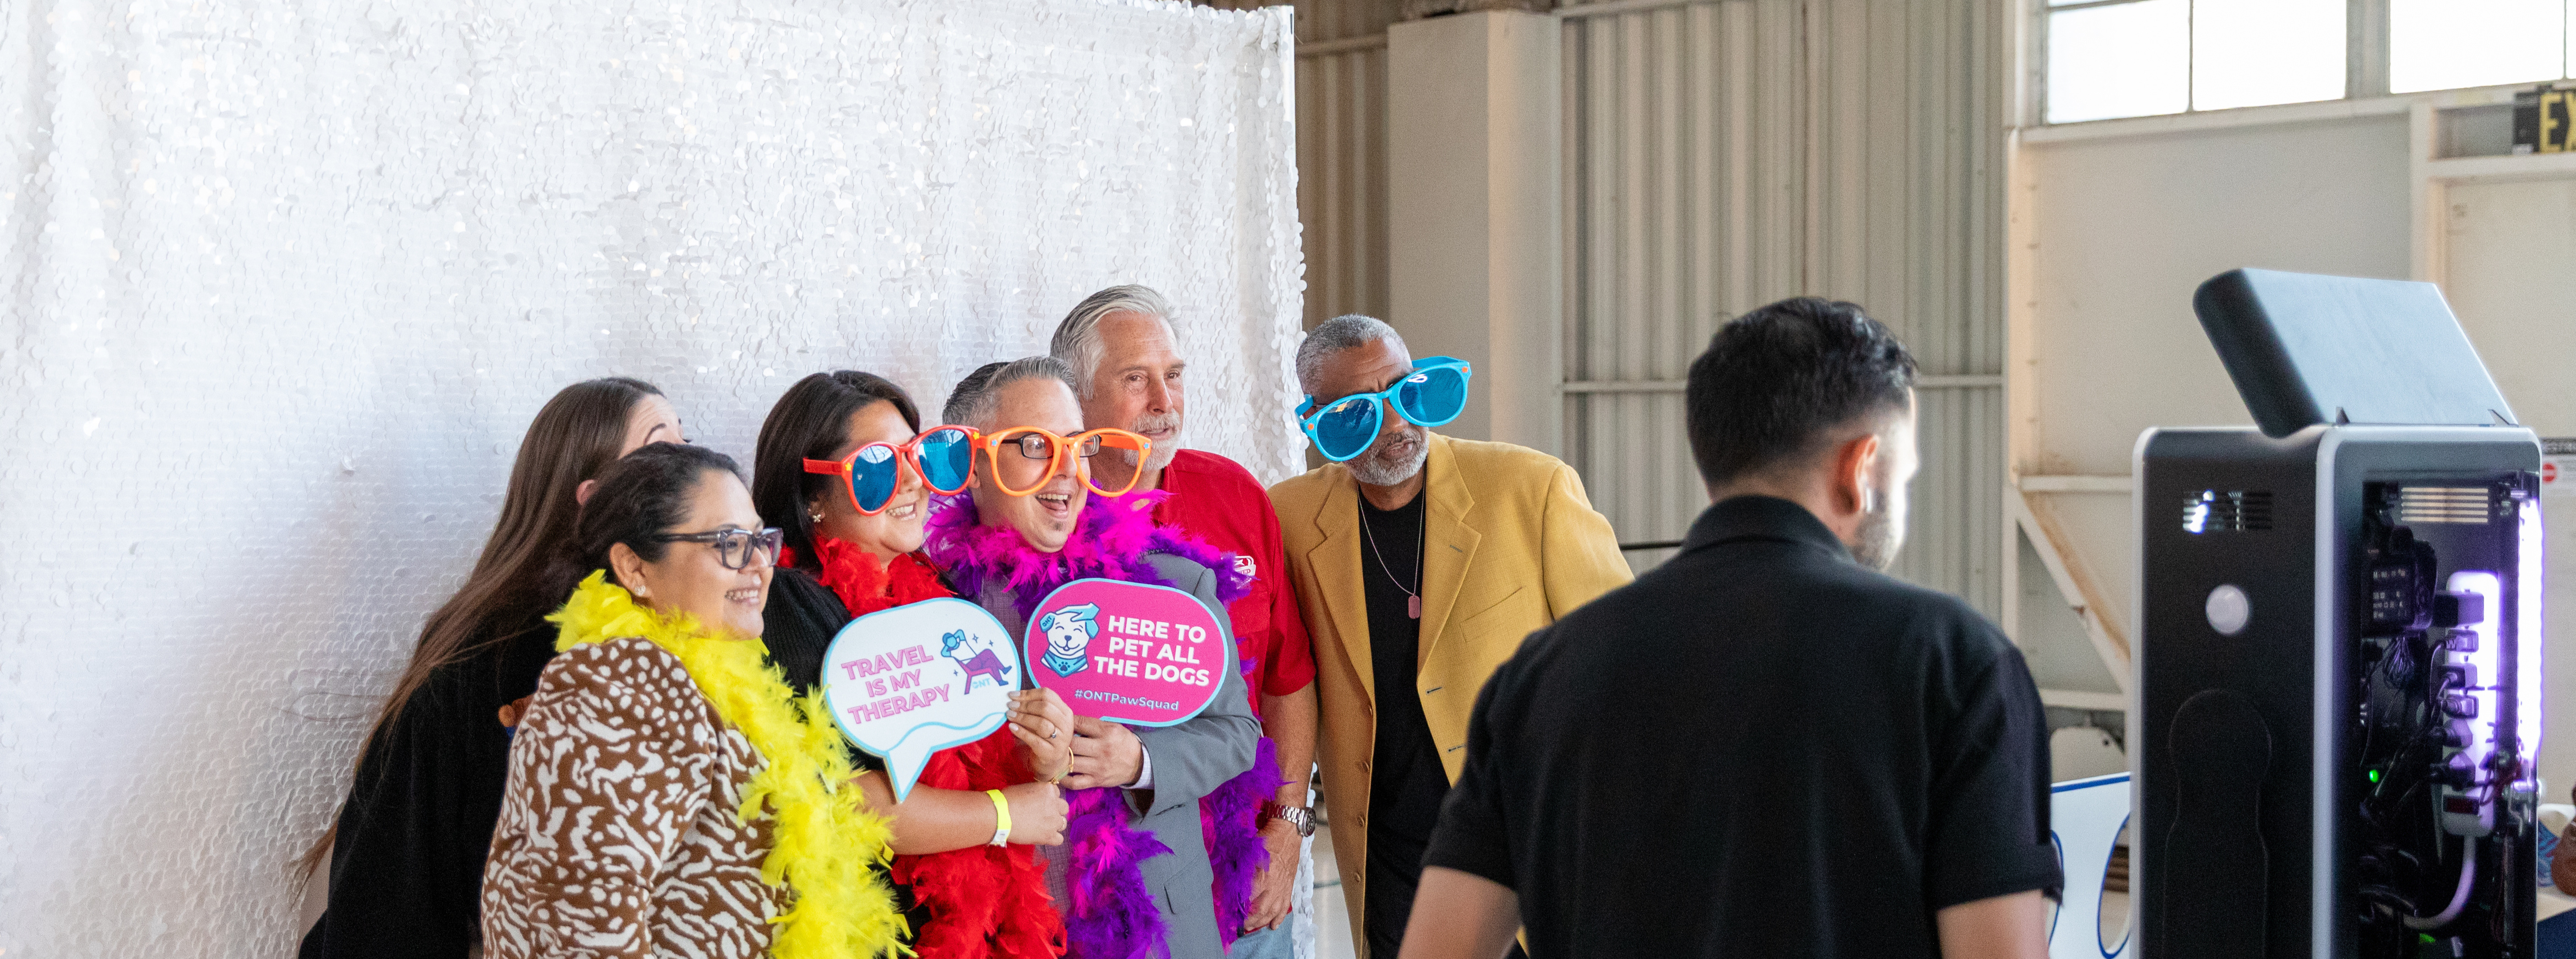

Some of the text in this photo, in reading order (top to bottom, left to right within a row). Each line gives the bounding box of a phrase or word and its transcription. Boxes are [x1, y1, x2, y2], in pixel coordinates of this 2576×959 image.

[1108, 615, 1206, 643] HERE TO
[841, 645, 934, 680] TRAVEL
[1108, 637, 1200, 664] PET ALL
[865, 669, 921, 698] IS MY
[1094, 656, 1209, 686] THE DOGS
[847, 683, 950, 724] THERAPY
[1075, 689, 1179, 711] #ONTPawSquad
